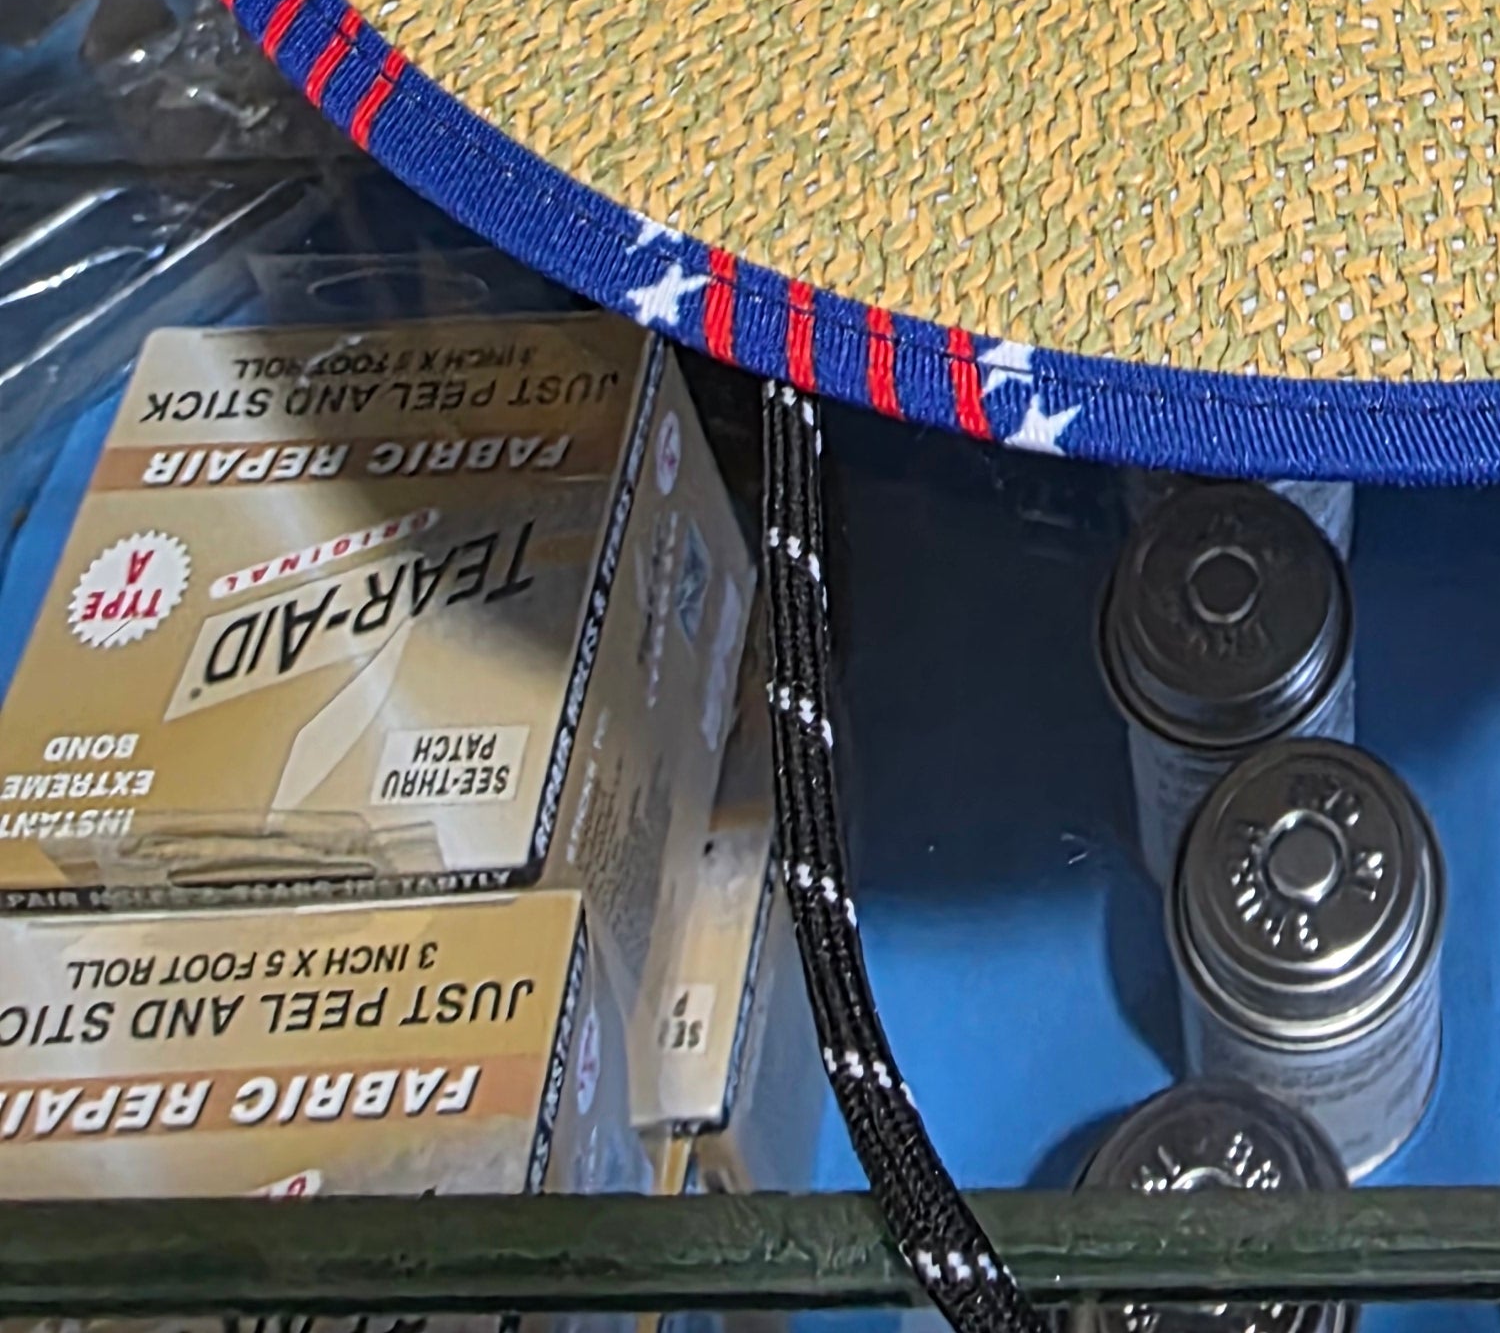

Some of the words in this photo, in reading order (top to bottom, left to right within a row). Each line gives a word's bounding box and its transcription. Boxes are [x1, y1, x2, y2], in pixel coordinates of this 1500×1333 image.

[139, 388, 273, 424] STICK
[285, 384, 381, 417] AND
[399, 378, 497, 412] PEEL
[506, 372, 620, 407] JUST
[141, 441, 353, 486] REPAIR
[364, 433, 575, 478] FABRIC
[124, 549, 156, 585] A
[223, 511, 431, 593] ORIGINAL
[81, 587, 163, 622] TYPE
[44, 733, 139, 762] BOND
[412, 733, 498, 763] PATCH
[0, 768, 156, 800] EXTREME
[381, 764, 511, 799] SEE-THRU
[66, 955, 157, 990] ROLL
[159, 951, 258, 986] FOOT
[265, 950, 287, 980] 5
[293, 949, 320, 979] X
[322, 943, 409, 976] INCH
[418, 941, 439, 970] 3
[131, 995, 245, 1041] AND
[260, 986, 390, 1035] PEEL
[398, 978, 536, 1027] JUST
[0, 1079, 214, 1135] REPAI
[229, 1064, 482, 1126] FABRIC
